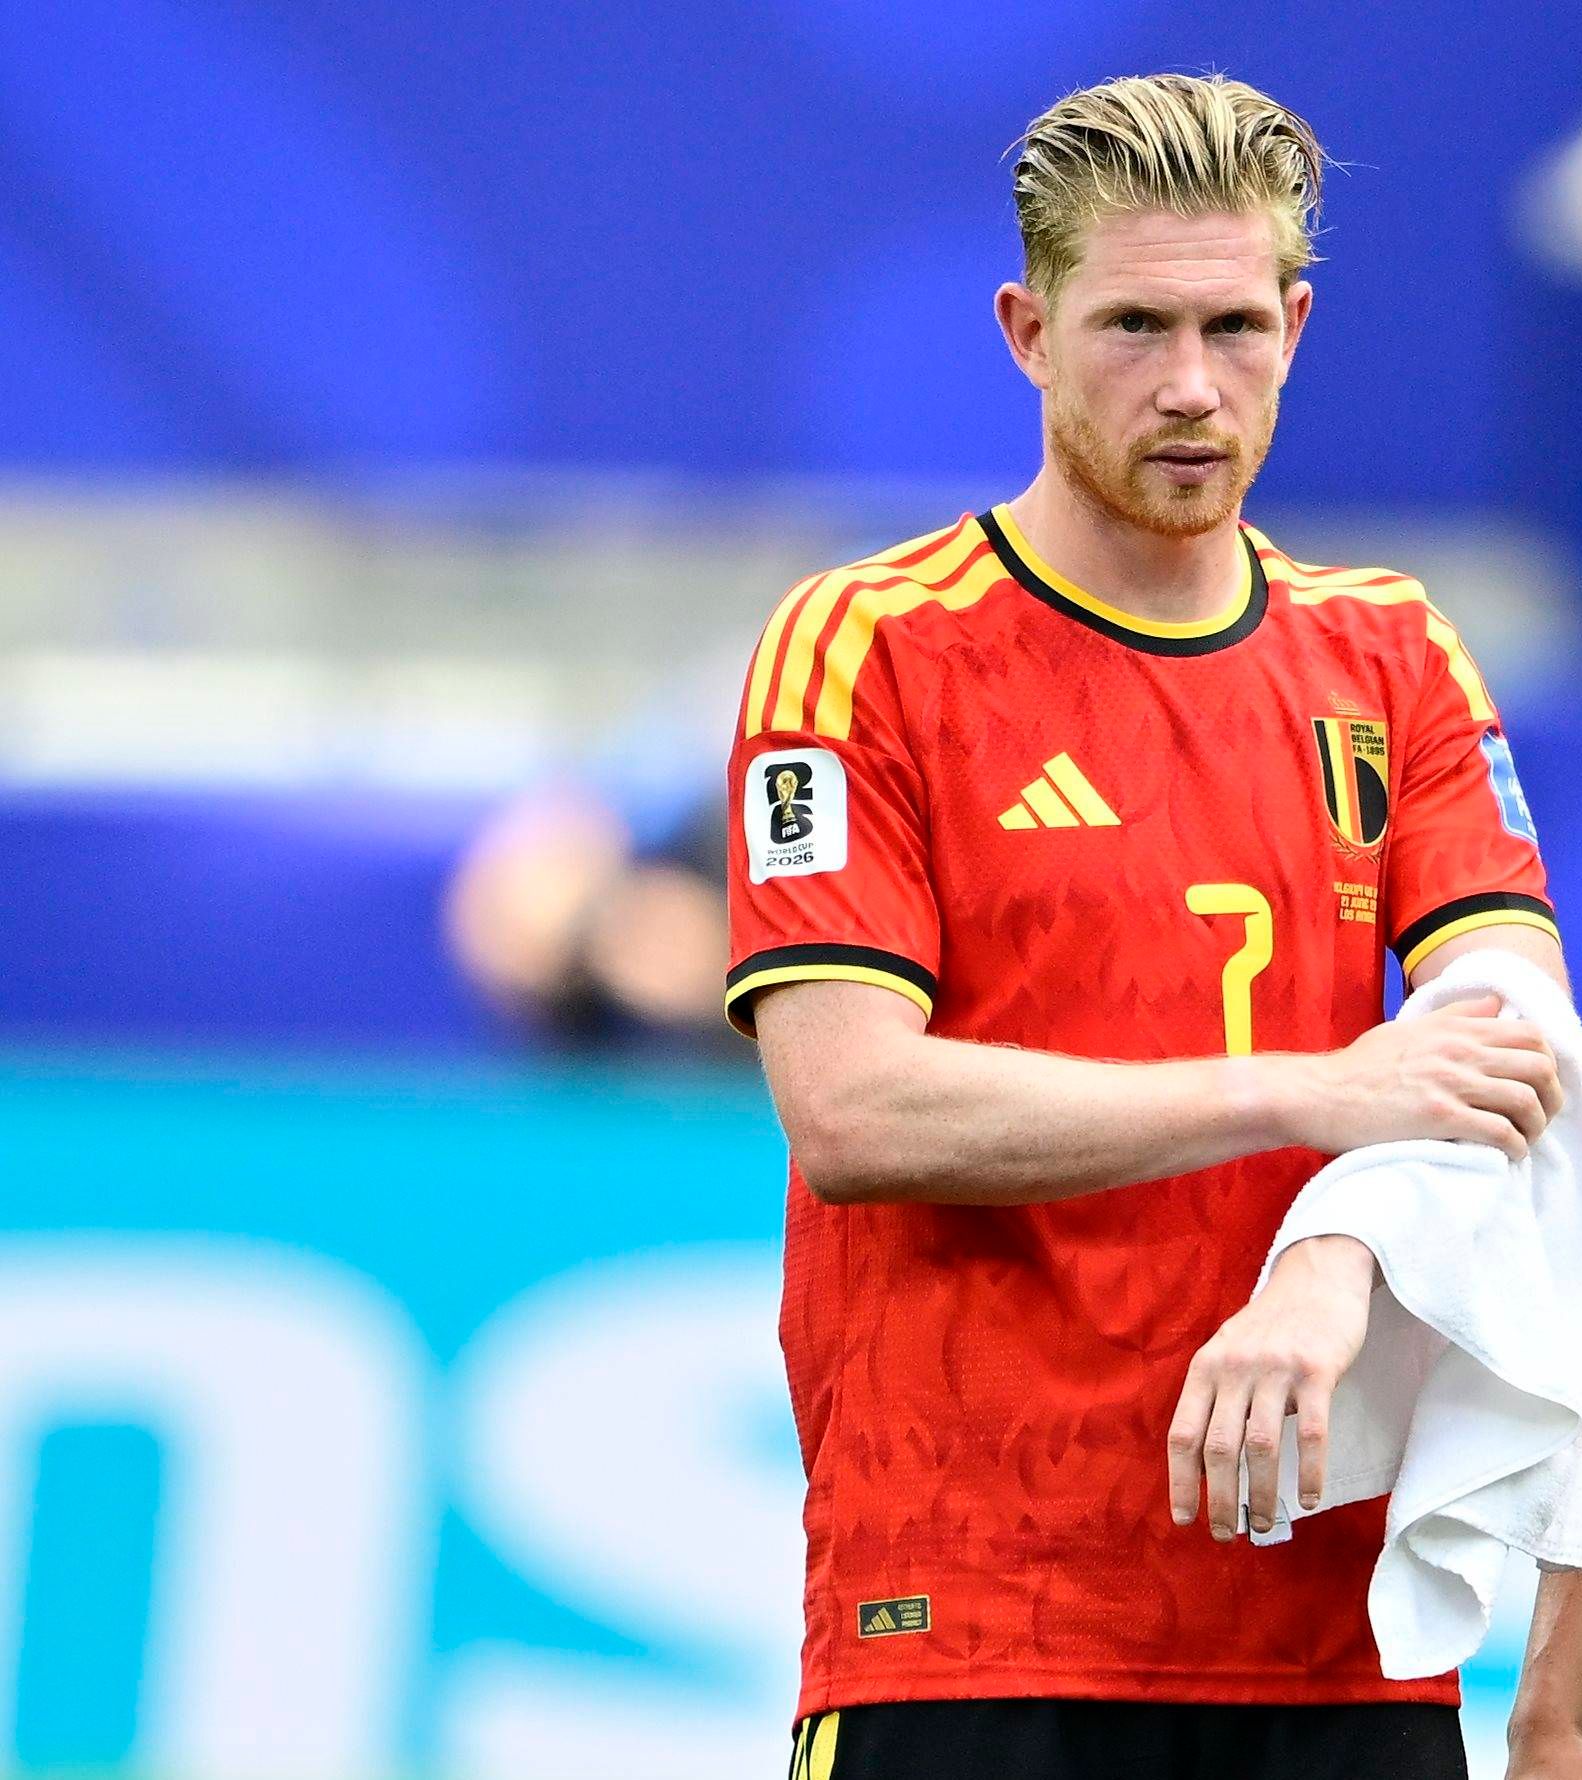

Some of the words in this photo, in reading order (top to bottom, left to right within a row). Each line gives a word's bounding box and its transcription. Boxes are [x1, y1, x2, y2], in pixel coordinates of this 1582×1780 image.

[1350, 723, 1375, 735] ROYAL
[782, 823, 800, 838] FIFA
[766, 851, 814, 867] 2026
[1185, 883, 1274, 1057] 7
